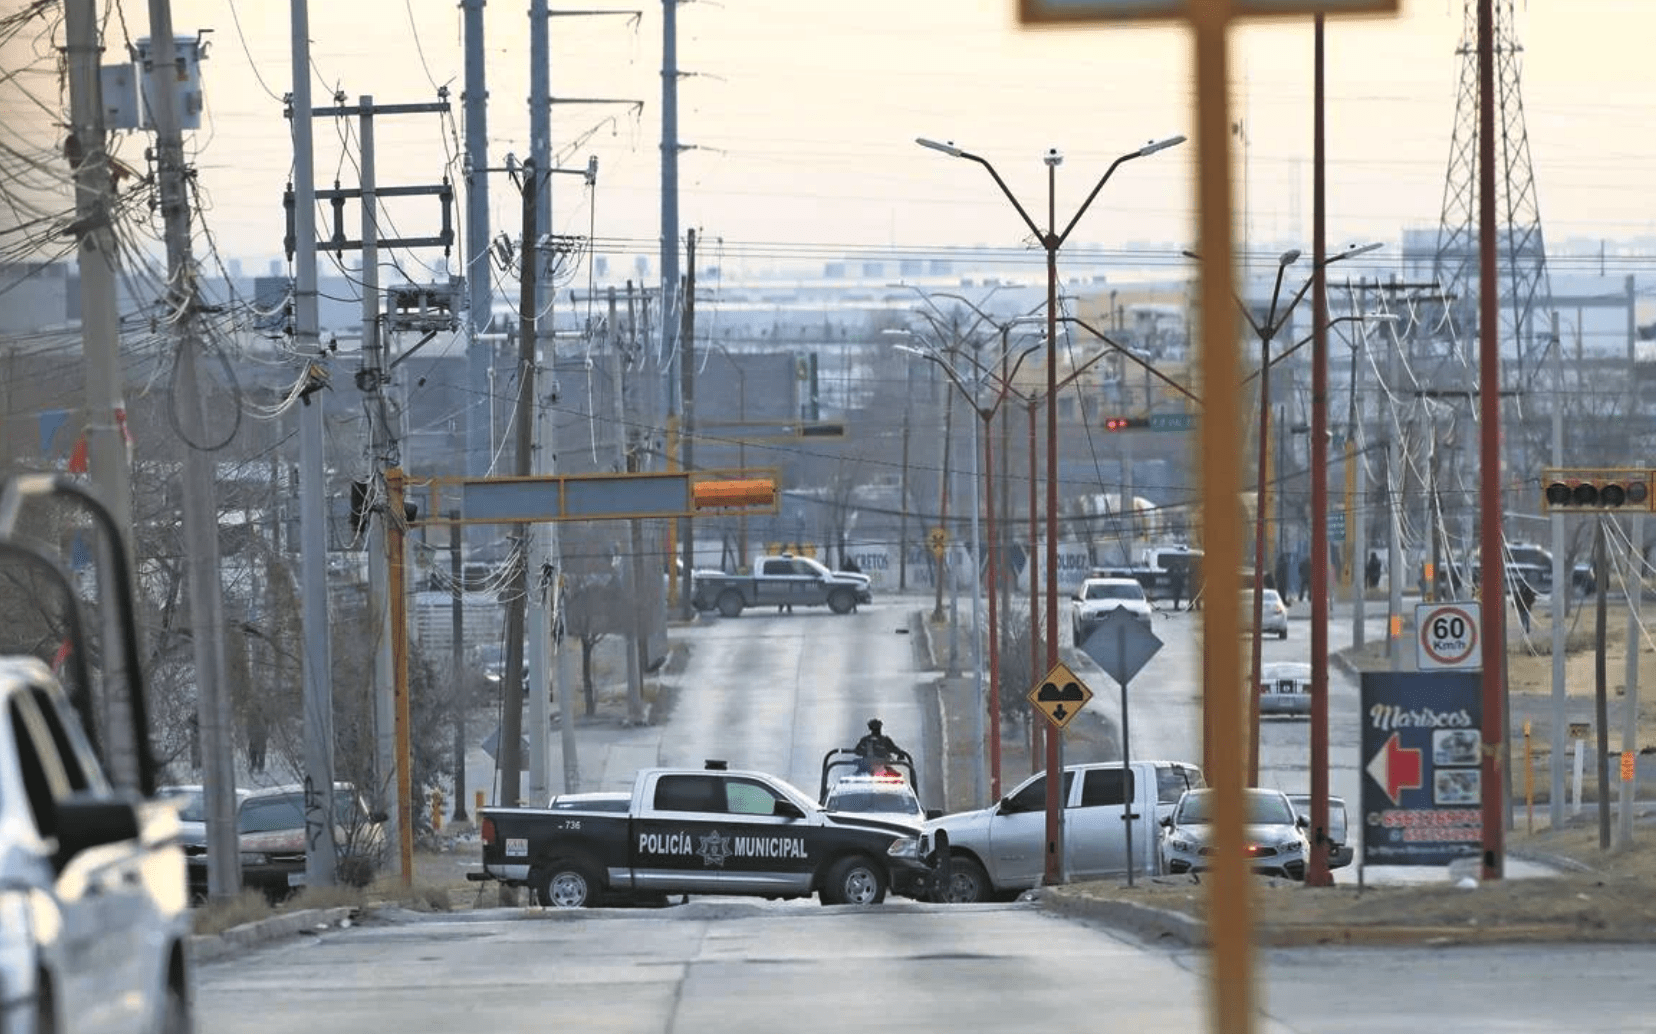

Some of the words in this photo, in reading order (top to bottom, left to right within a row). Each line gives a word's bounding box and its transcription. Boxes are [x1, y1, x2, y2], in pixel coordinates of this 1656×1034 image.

[1433, 617, 1464, 640] 60
[1370, 703, 1471, 731] Mariscos
[639, 830, 693, 856] POLICÍA
[734, 836, 808, 859] MUNICIPAL
